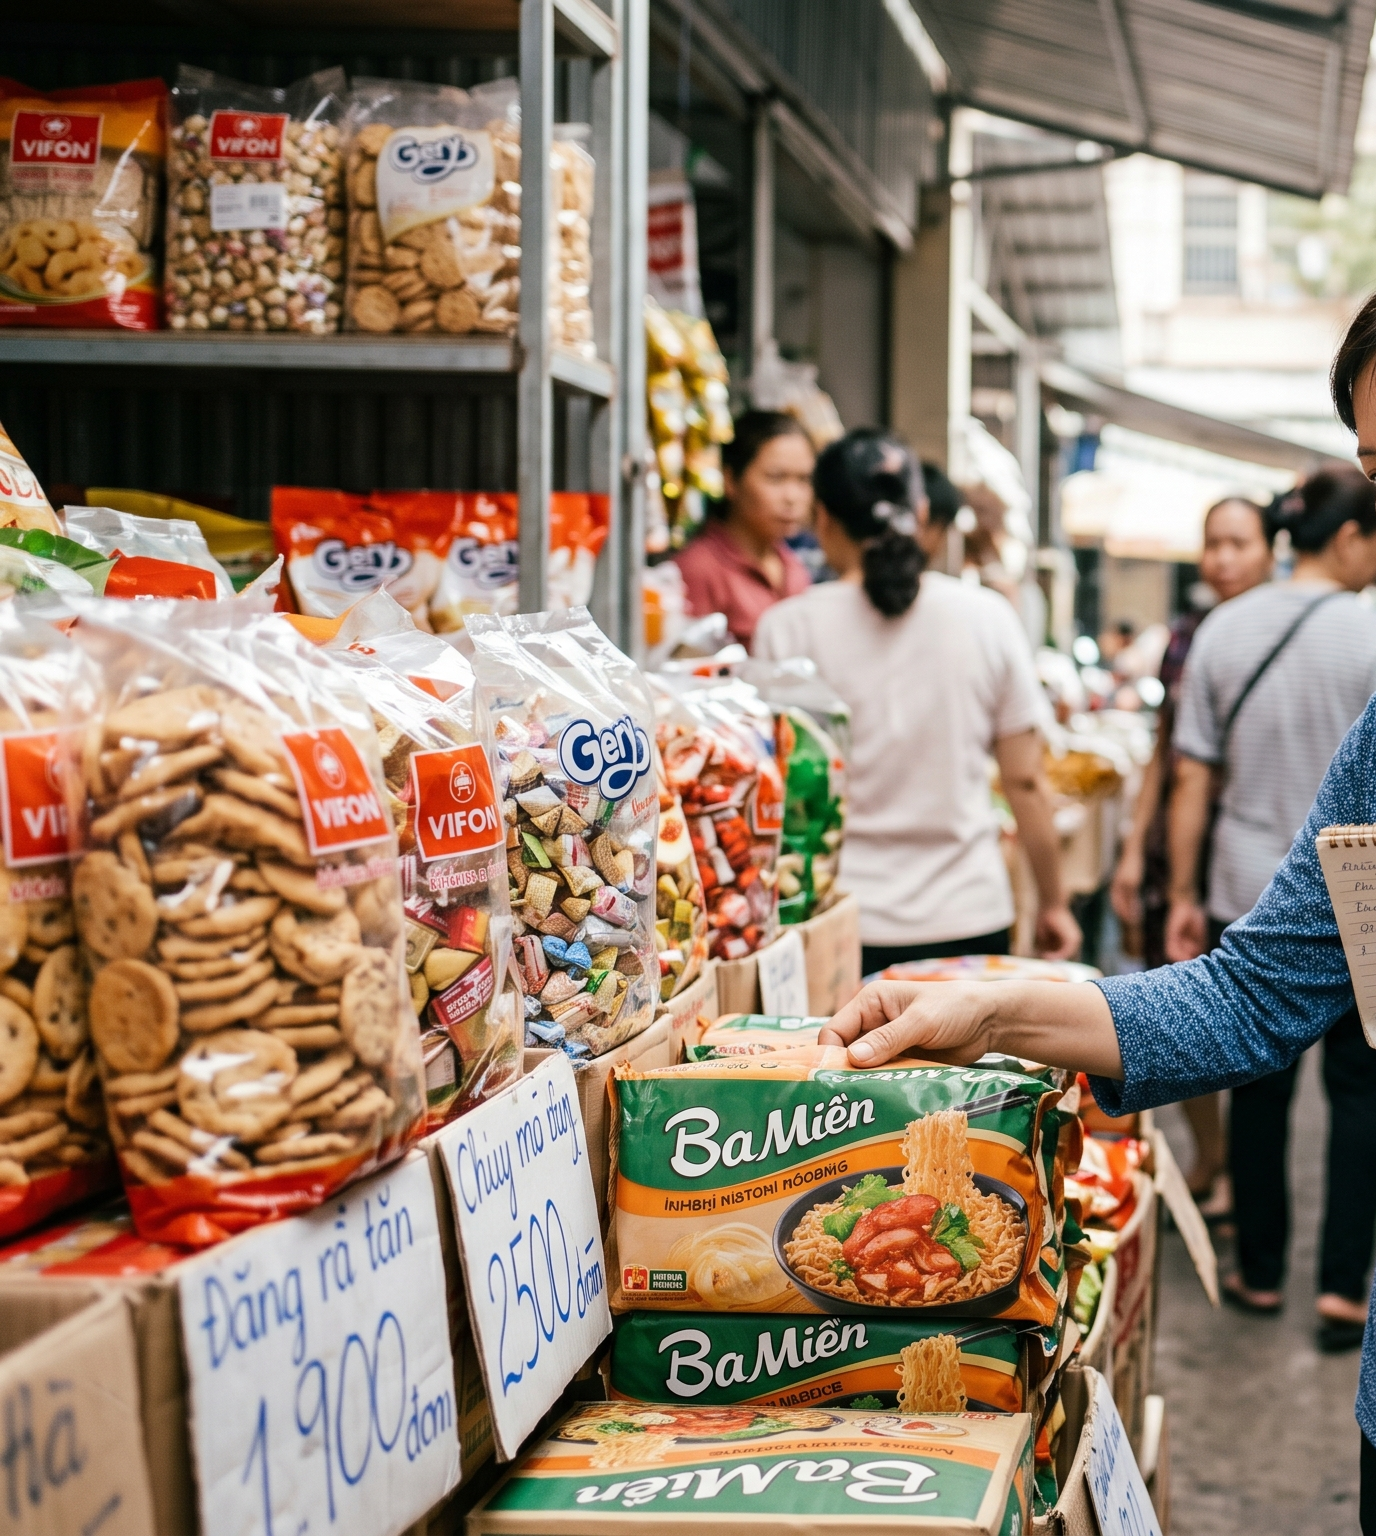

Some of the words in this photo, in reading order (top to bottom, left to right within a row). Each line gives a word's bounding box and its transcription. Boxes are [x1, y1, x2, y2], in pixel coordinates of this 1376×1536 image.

[21, 140, 91, 159] VIFON
[217, 136, 279, 155] VIFON
[389, 134, 478, 184] Gery
[314, 539, 414, 592] Gery
[558, 714, 650, 800] Gery
[313, 792, 382, 829] VIFON
[428, 805, 498, 840] VIFON
[488, 1199, 572, 1398] 2500
